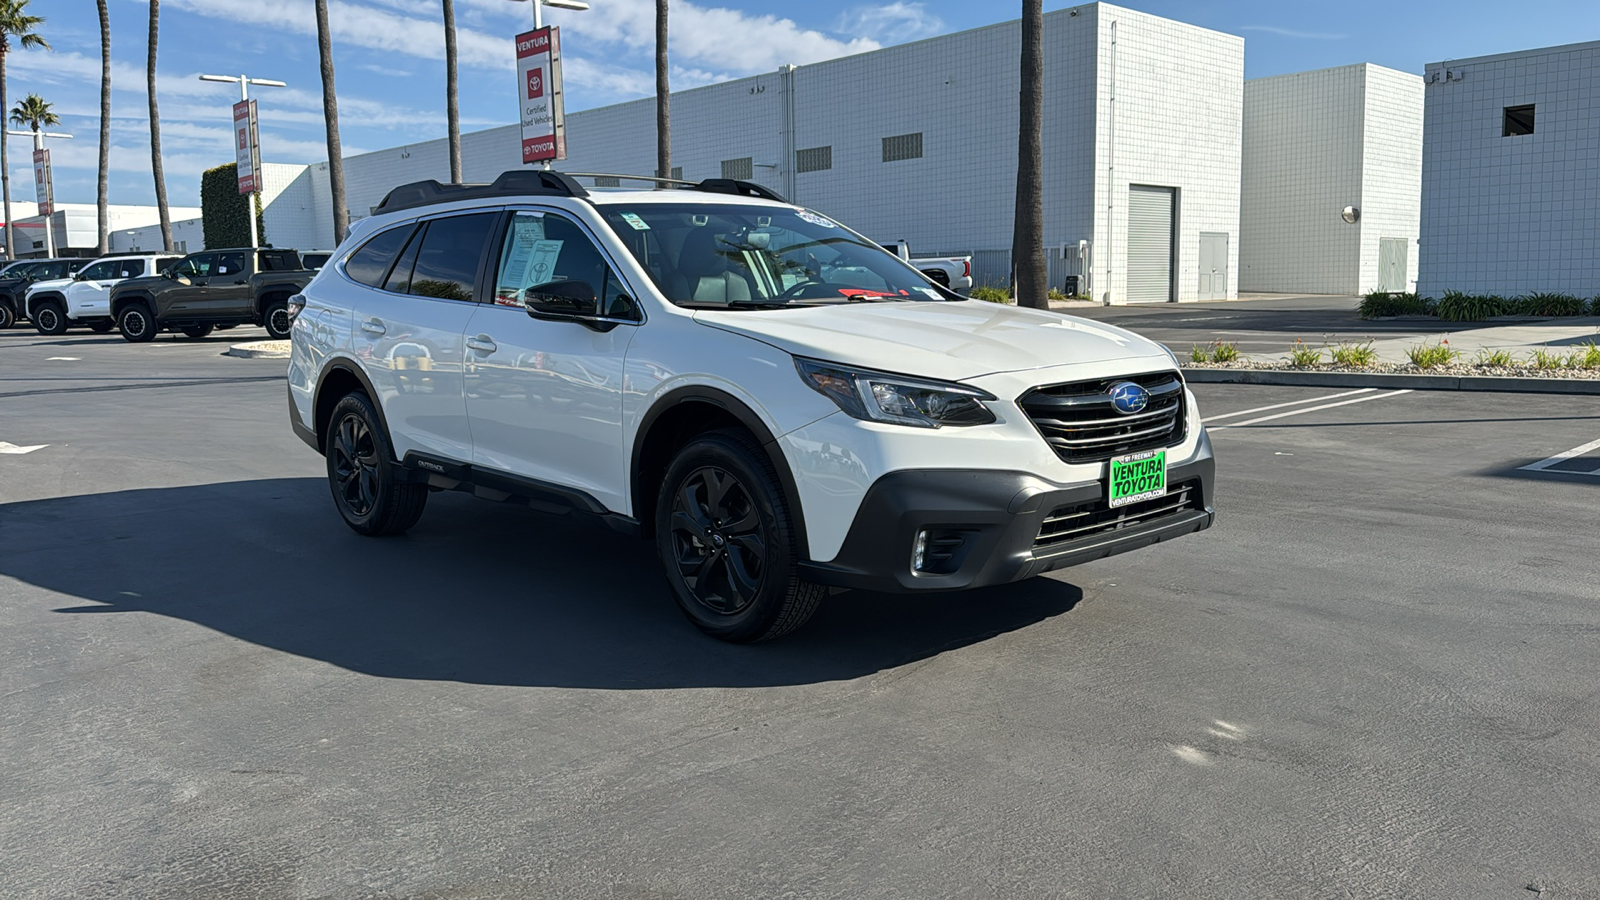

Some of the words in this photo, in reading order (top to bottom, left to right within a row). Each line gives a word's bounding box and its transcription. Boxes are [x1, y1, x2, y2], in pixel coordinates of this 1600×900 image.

[517, 35, 549, 52] VENTURA
[526, 104, 546, 115] Certified
[522, 117, 534, 128] Used
[534, 114, 553, 125] Vehicles
[531, 142, 554, 153] TOYOTA
[418, 460, 445, 473] OUTBACK
[1114, 459, 1162, 481] VENTURA
[1115, 474, 1160, 496] TOYOTA
[1112, 489, 1163, 506] VENTURATOYOTA.COM
